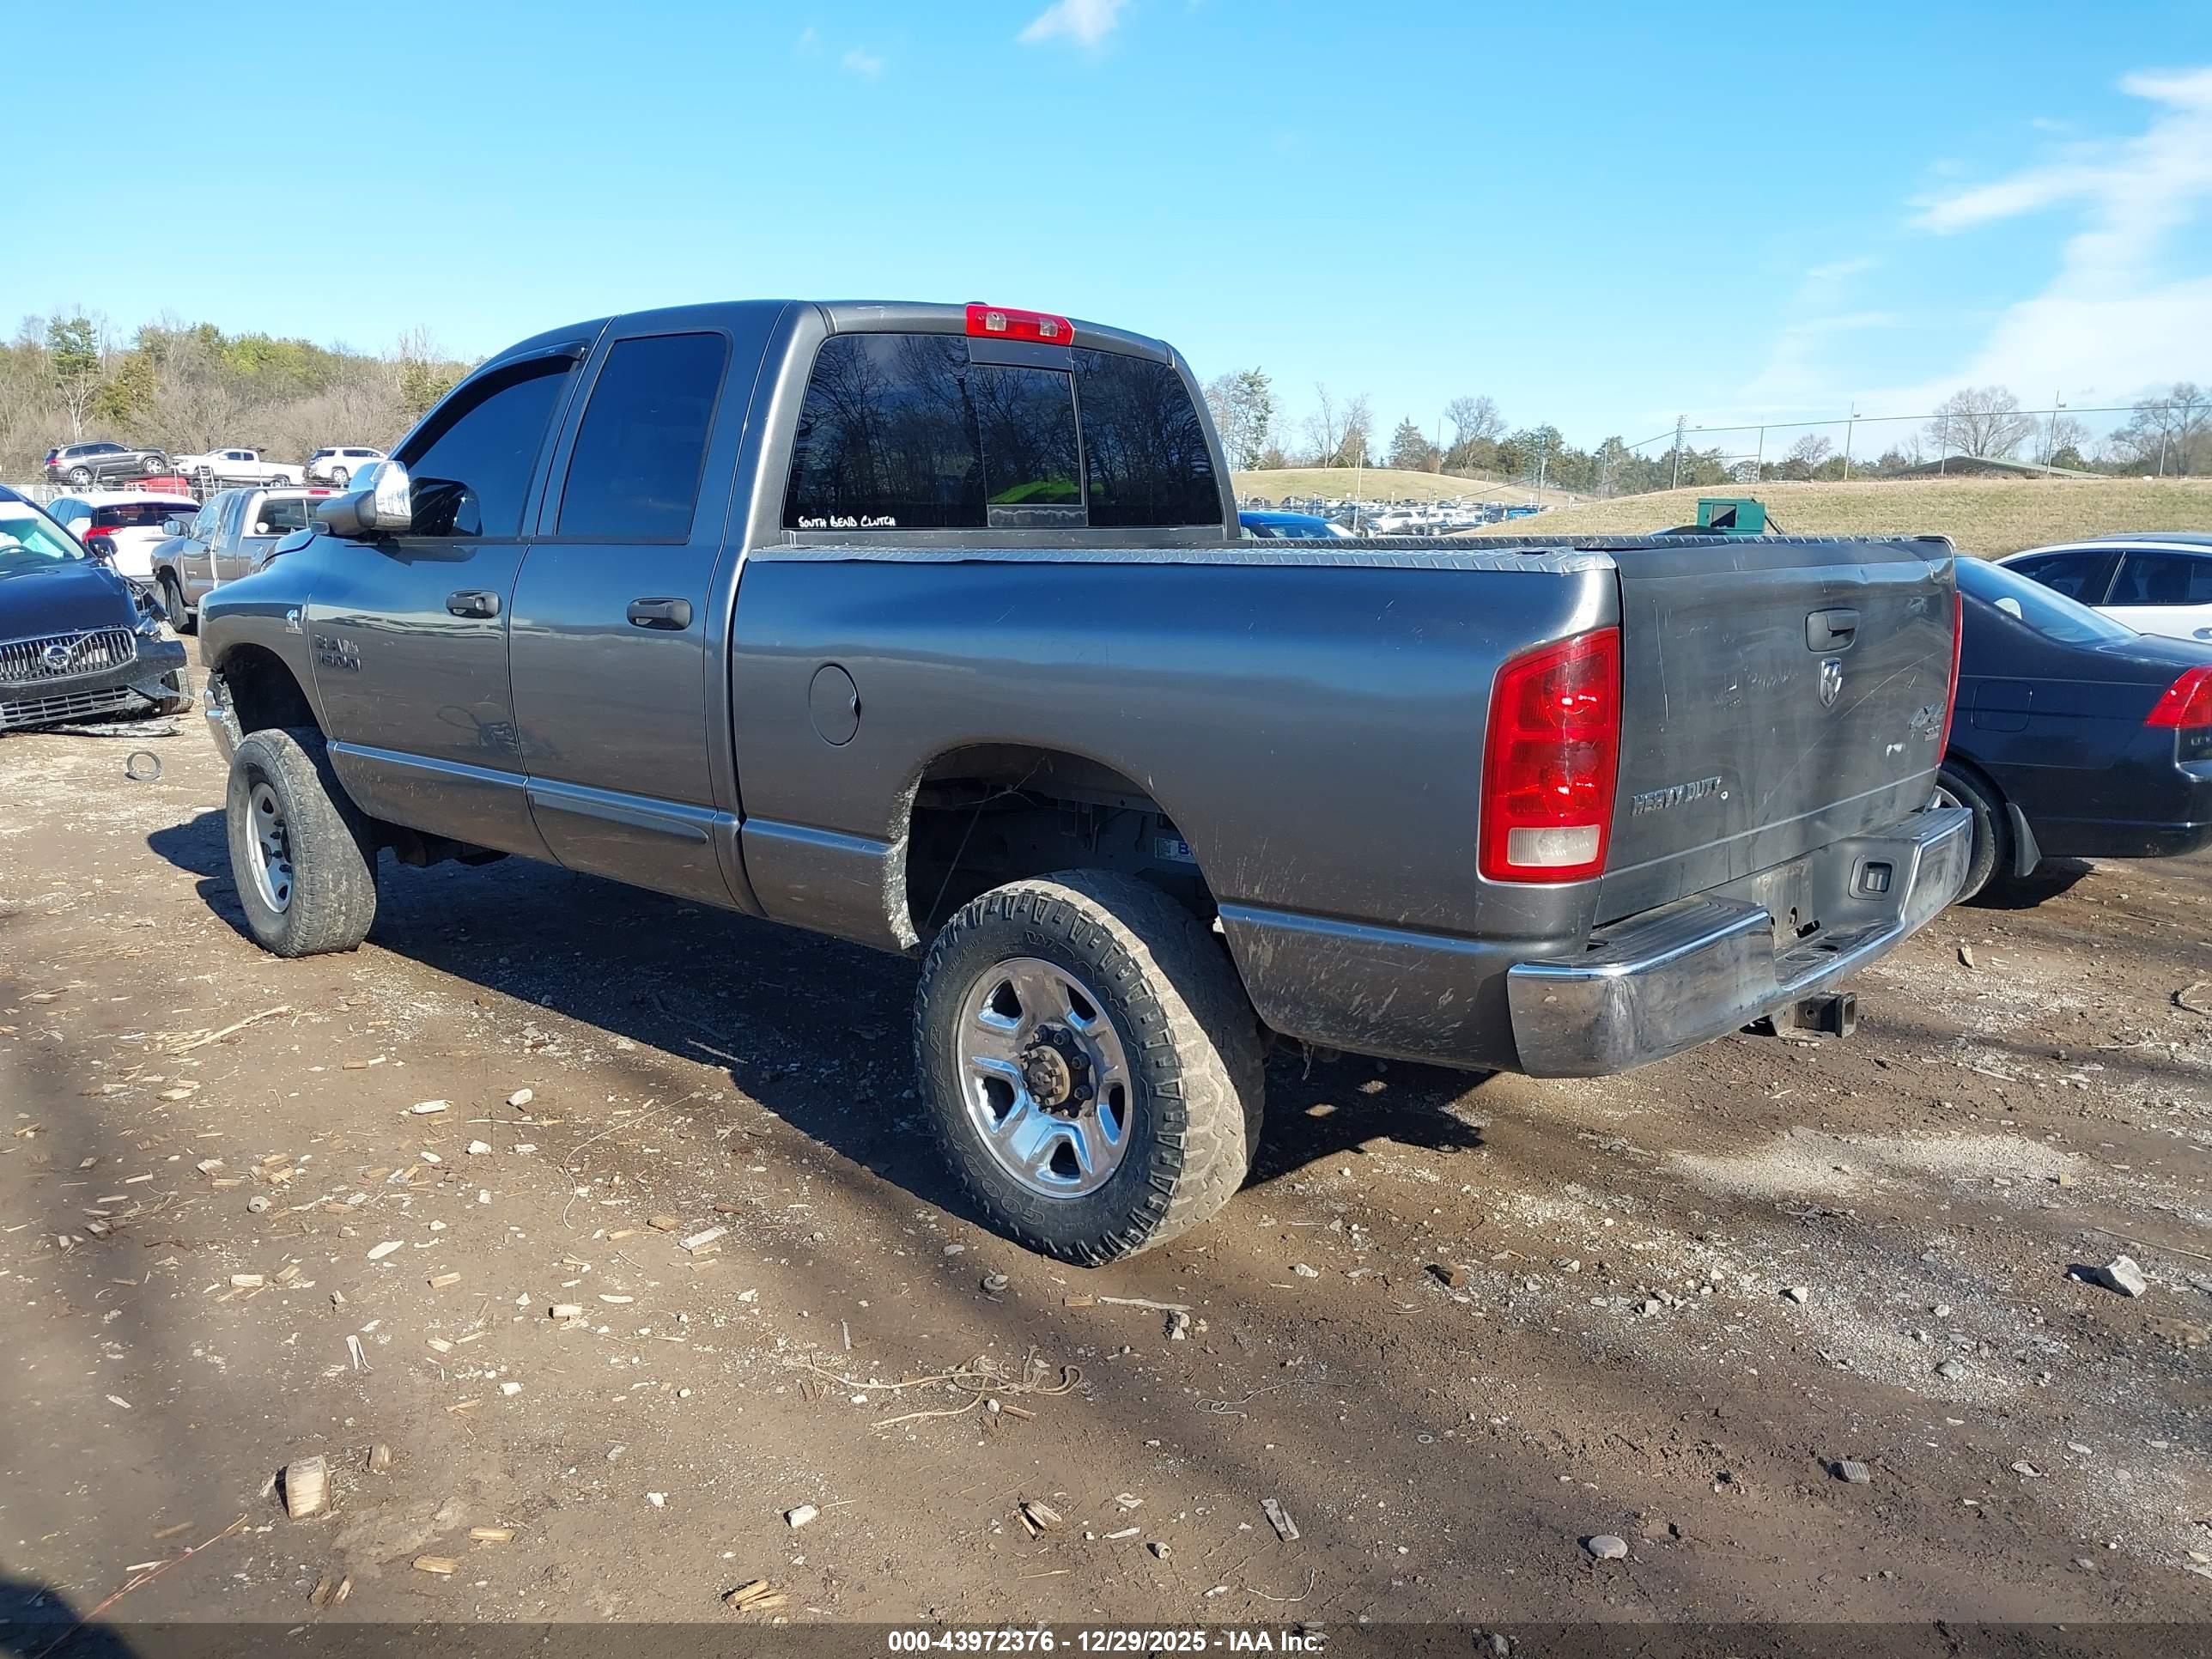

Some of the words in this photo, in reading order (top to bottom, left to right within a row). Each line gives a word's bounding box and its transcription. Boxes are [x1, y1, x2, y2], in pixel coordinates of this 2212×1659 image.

[799, 515, 827, 528] SOUTH
[830, 514, 858, 527] BEND
[860, 514, 896, 527] CLUTCH
[1630, 784, 1684, 817] HEAVY
[1683, 775, 1722, 804] DUTY
